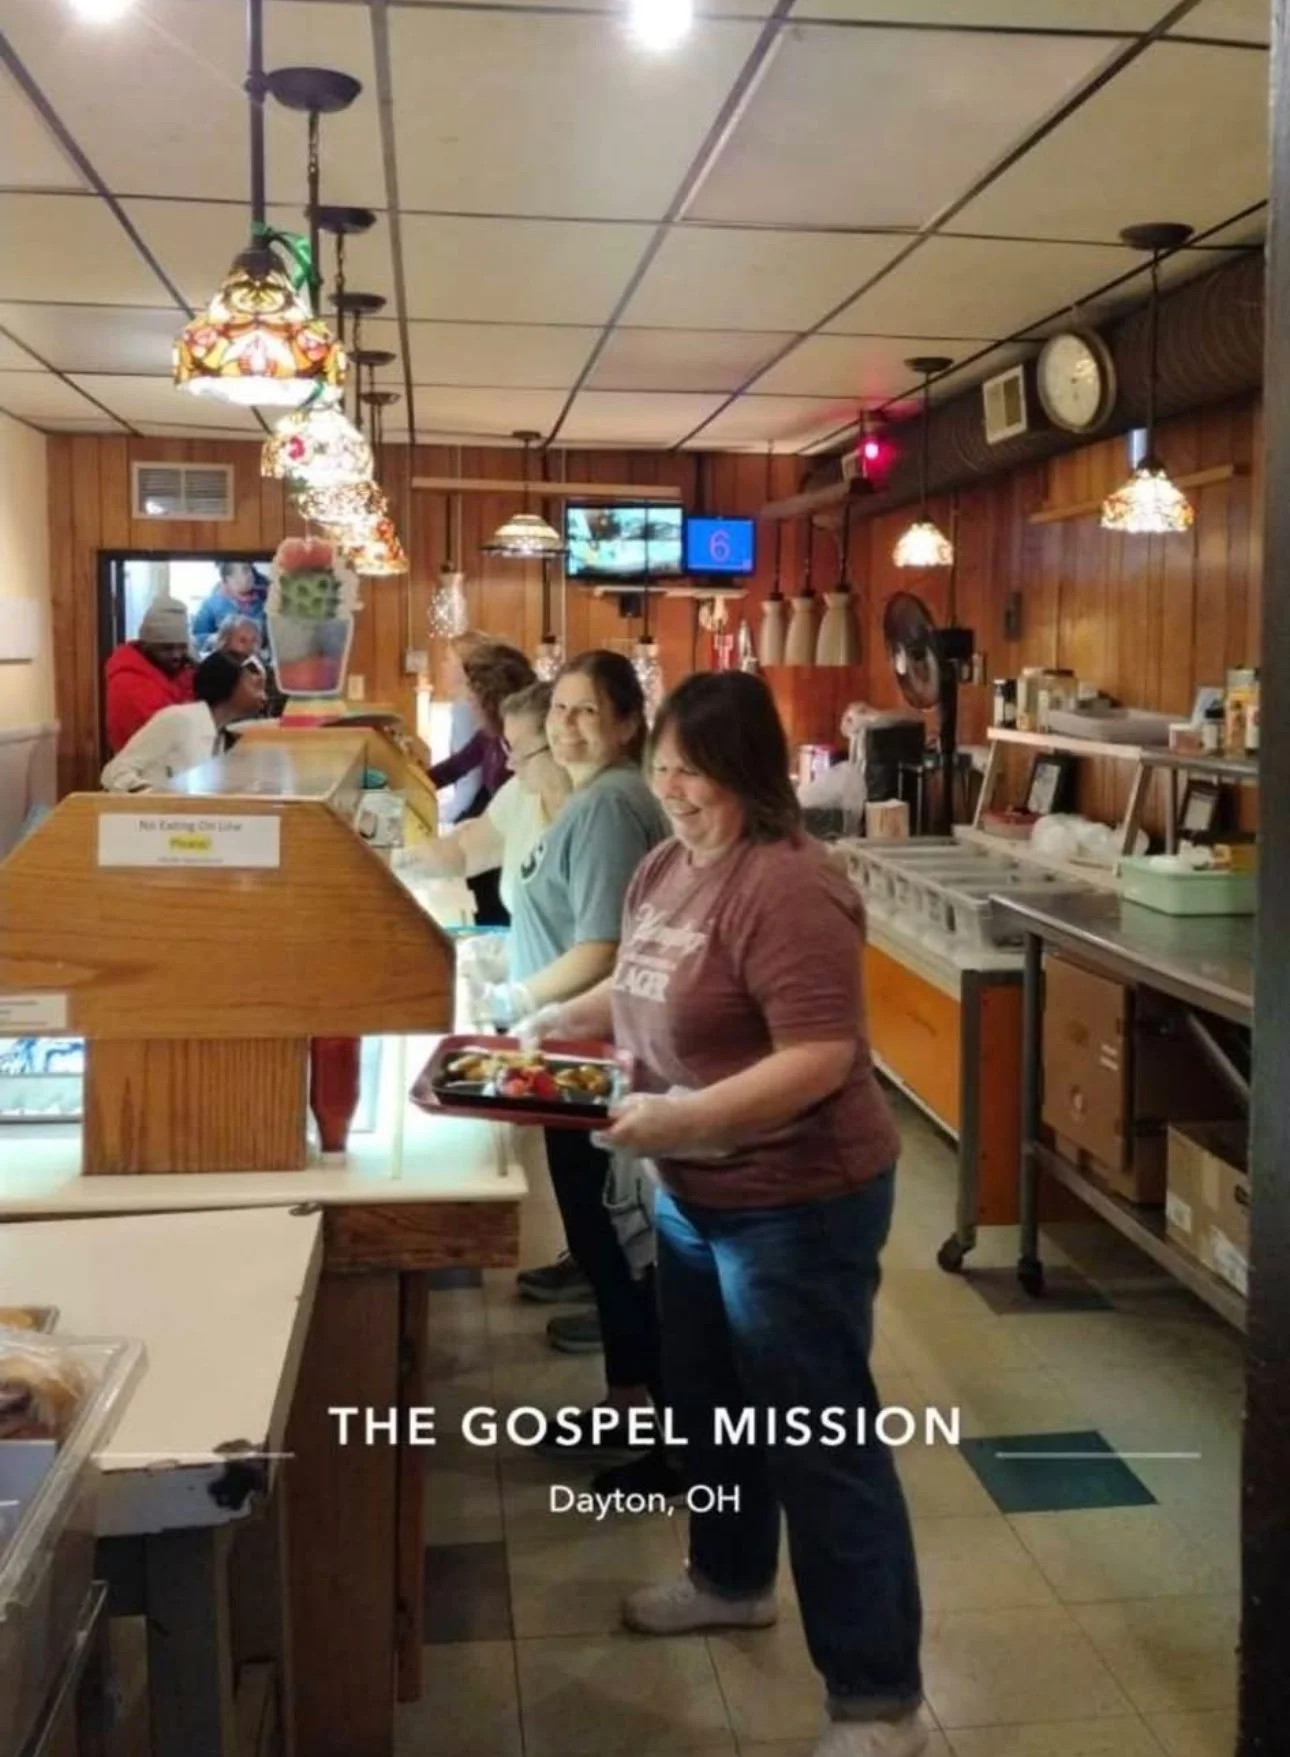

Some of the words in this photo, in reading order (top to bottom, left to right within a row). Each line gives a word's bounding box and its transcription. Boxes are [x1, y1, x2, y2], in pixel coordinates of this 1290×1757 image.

[708, 529, 731, 562] 6
[138, 819, 157, 832] No
[159, 819, 195, 834] Eating
[197, 819, 216, 832] On
